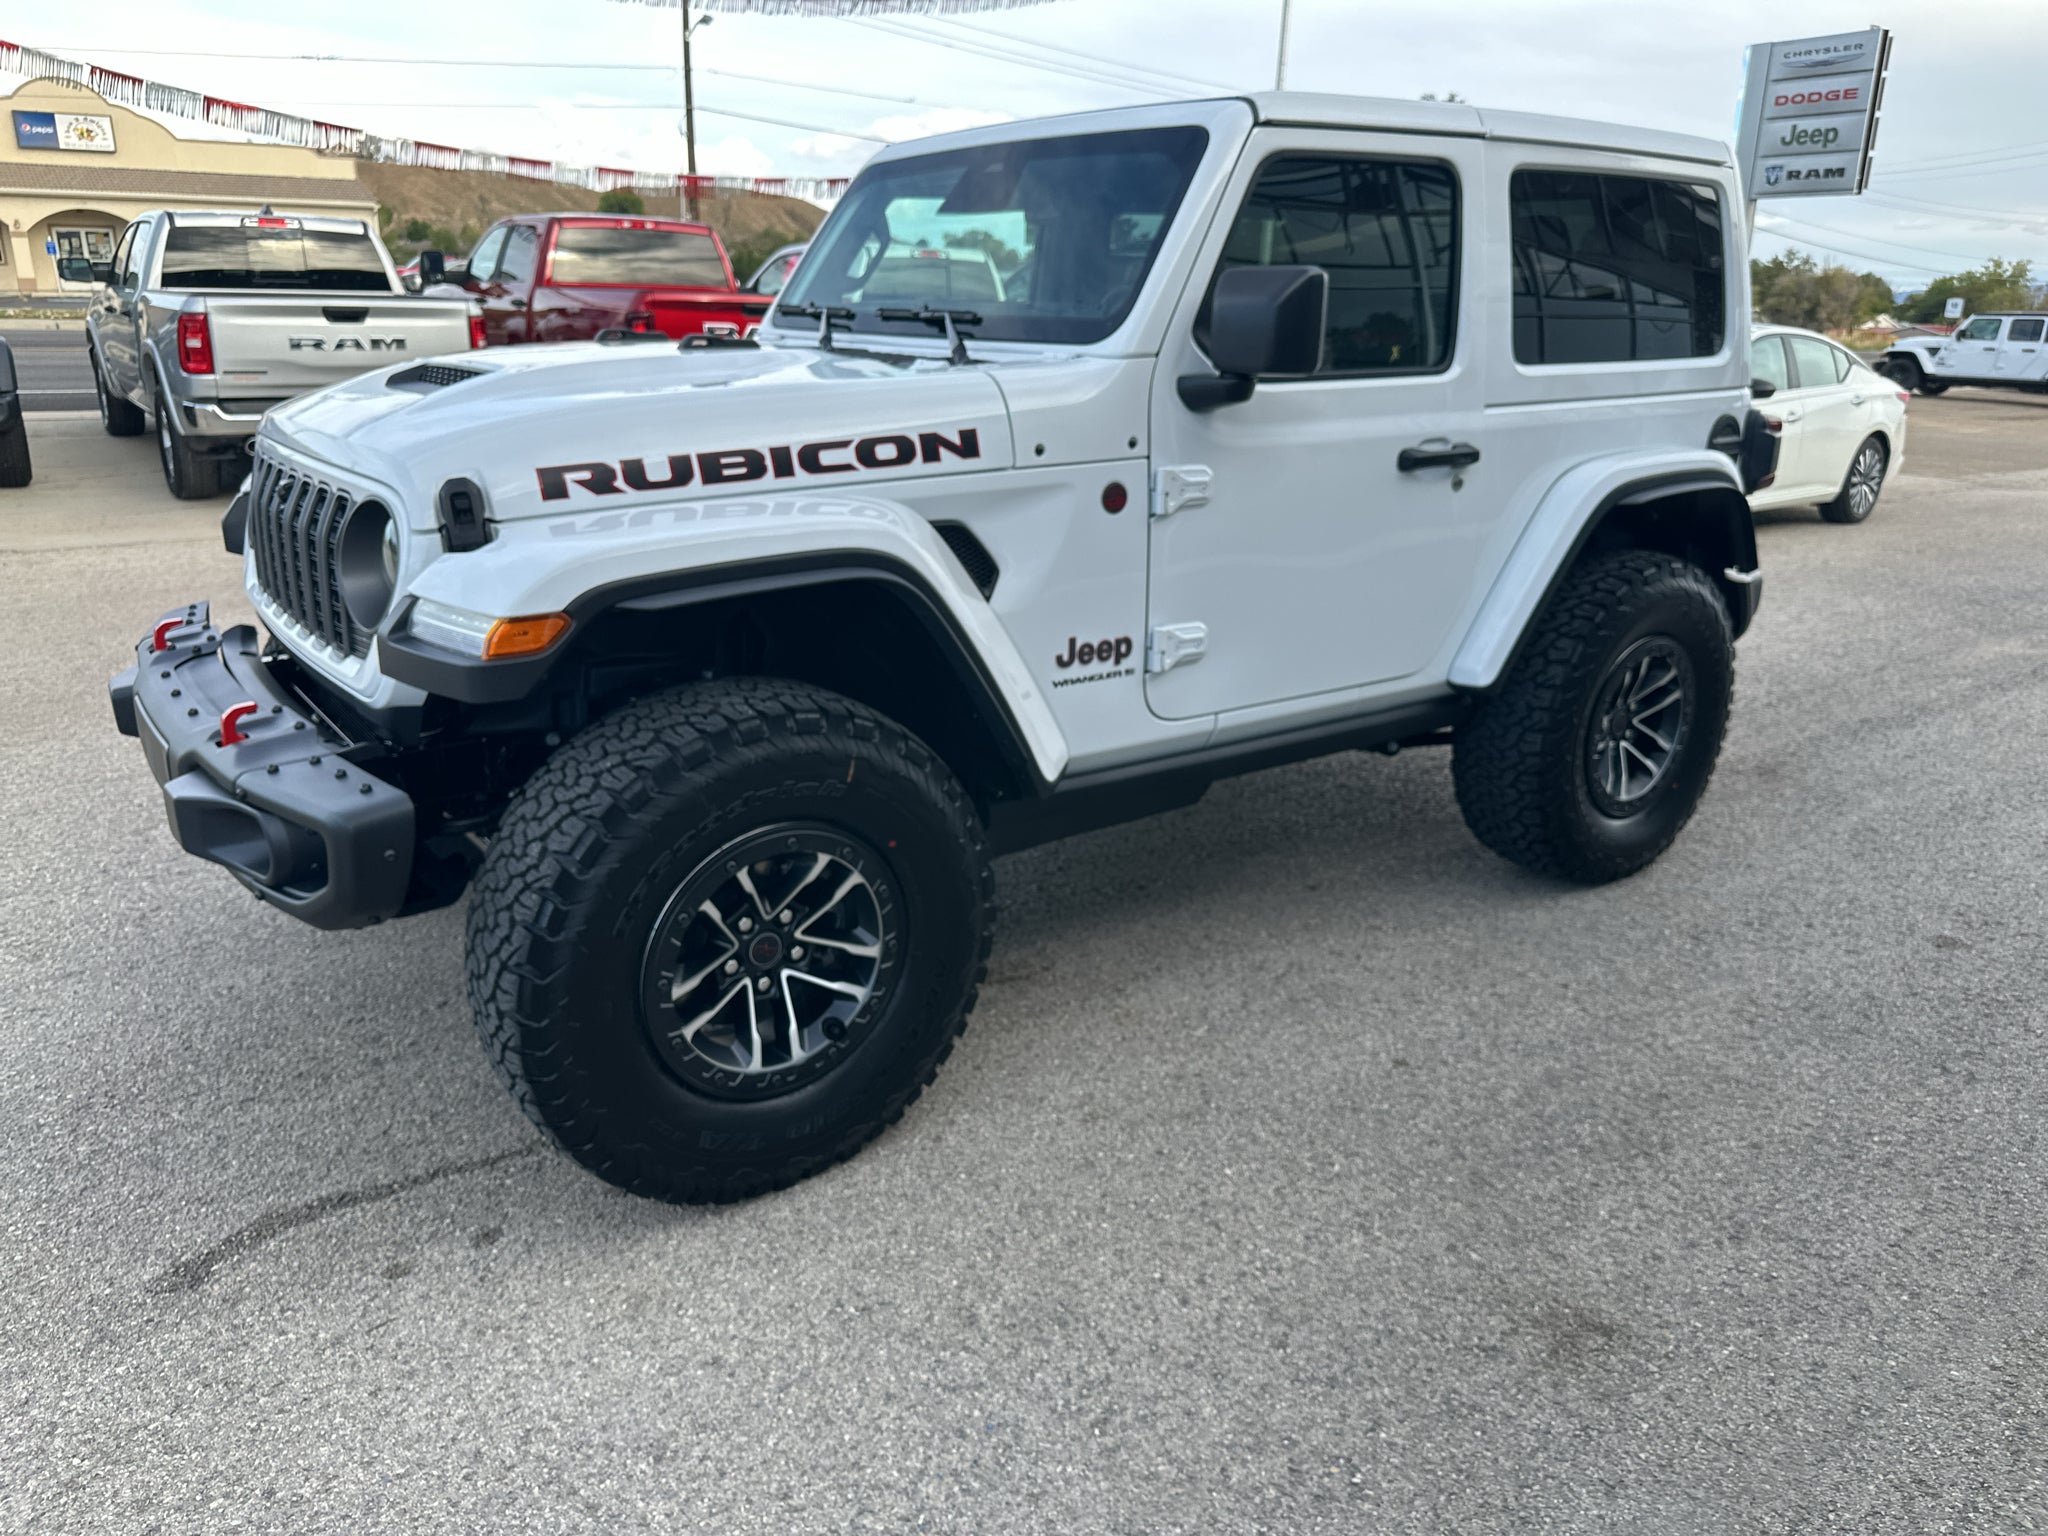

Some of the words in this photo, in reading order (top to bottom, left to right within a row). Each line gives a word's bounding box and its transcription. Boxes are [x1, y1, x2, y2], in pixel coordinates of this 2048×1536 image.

[1783, 43, 1864, 59] CHRYSLER
[1774, 88, 1859, 106] DODGE
[32, 125, 54, 135] pepsi
[1780, 124, 1838, 148] Jeep
[1786, 167, 1845, 180] RAM
[289, 335, 406, 351] RAM
[535, 428, 981, 501] RUBICON
[1055, 636, 1132, 668] Jeep
[1052, 669, 1122, 688] WRANGLER
